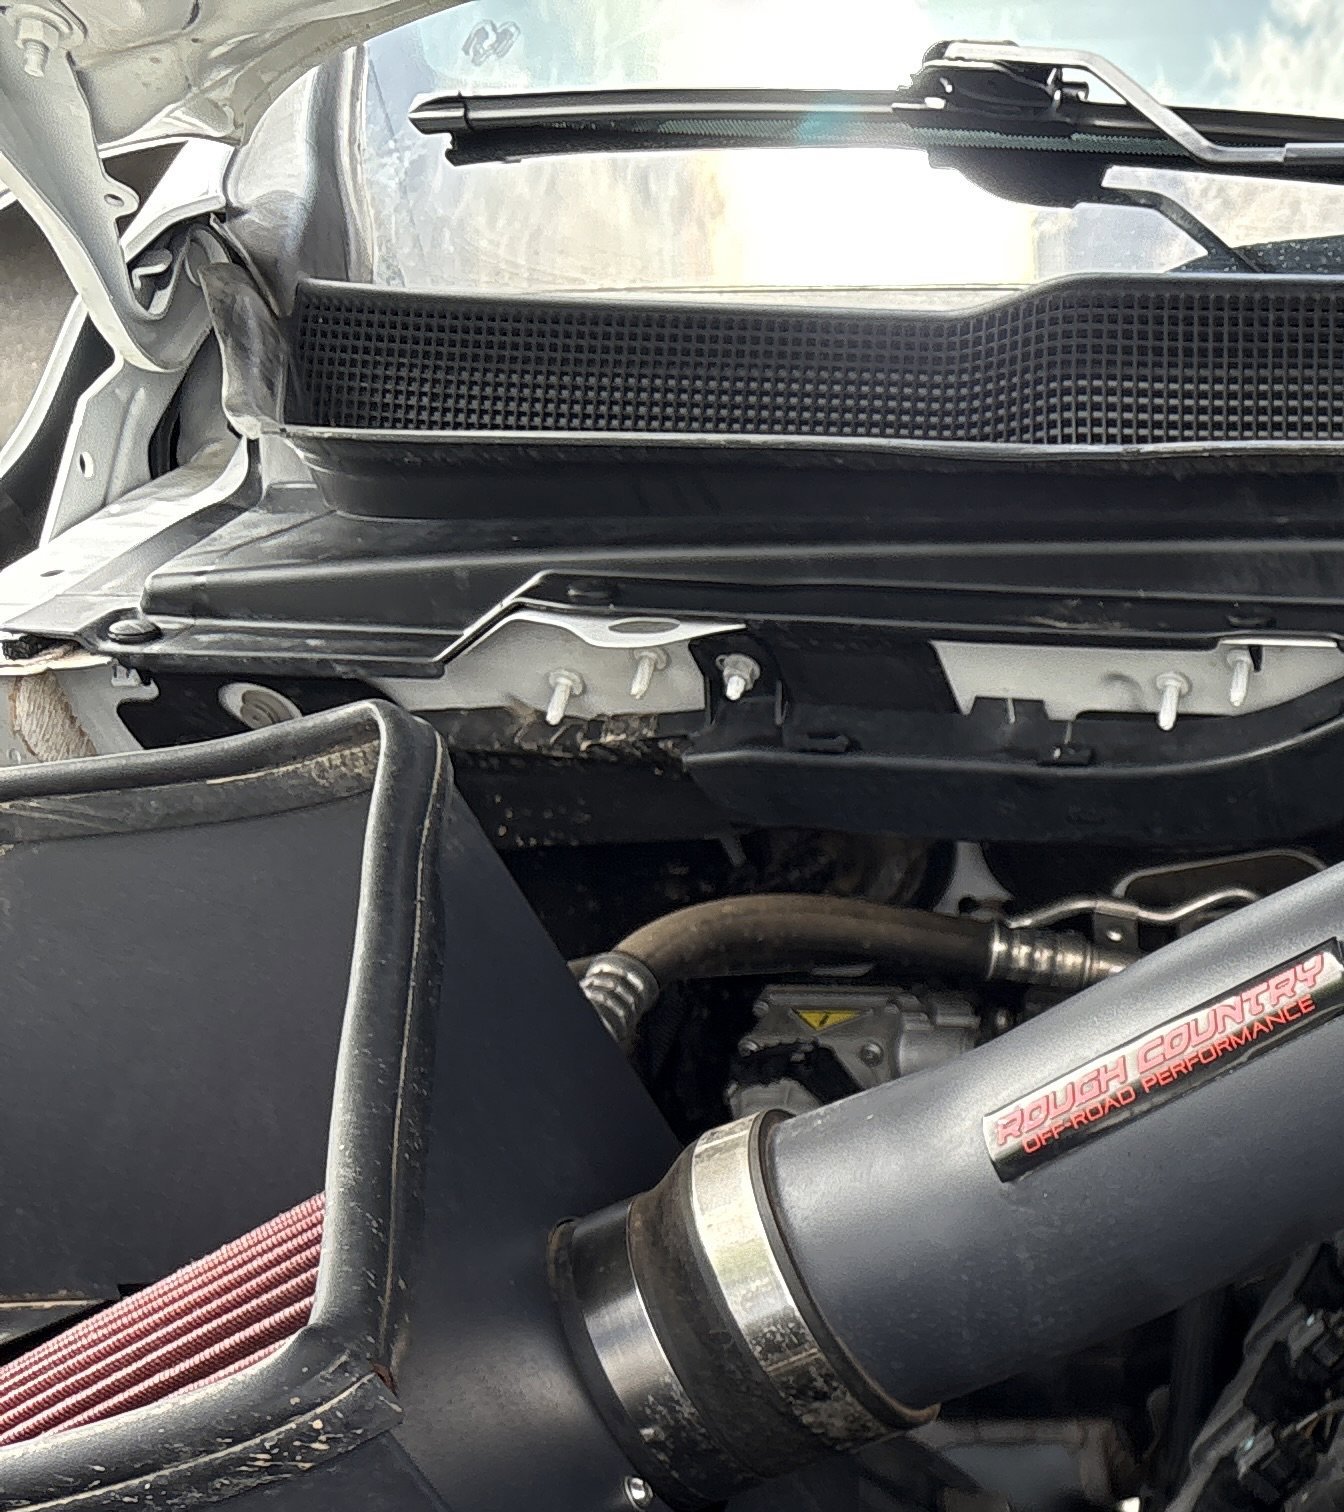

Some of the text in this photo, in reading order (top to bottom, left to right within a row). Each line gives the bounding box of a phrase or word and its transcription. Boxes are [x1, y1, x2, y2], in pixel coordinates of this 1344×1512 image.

[997, 951, 1324, 1147] ROUGH COUNTRY
[1020, 993, 1317, 1154] OFF-ROAD PERFORMANCE
